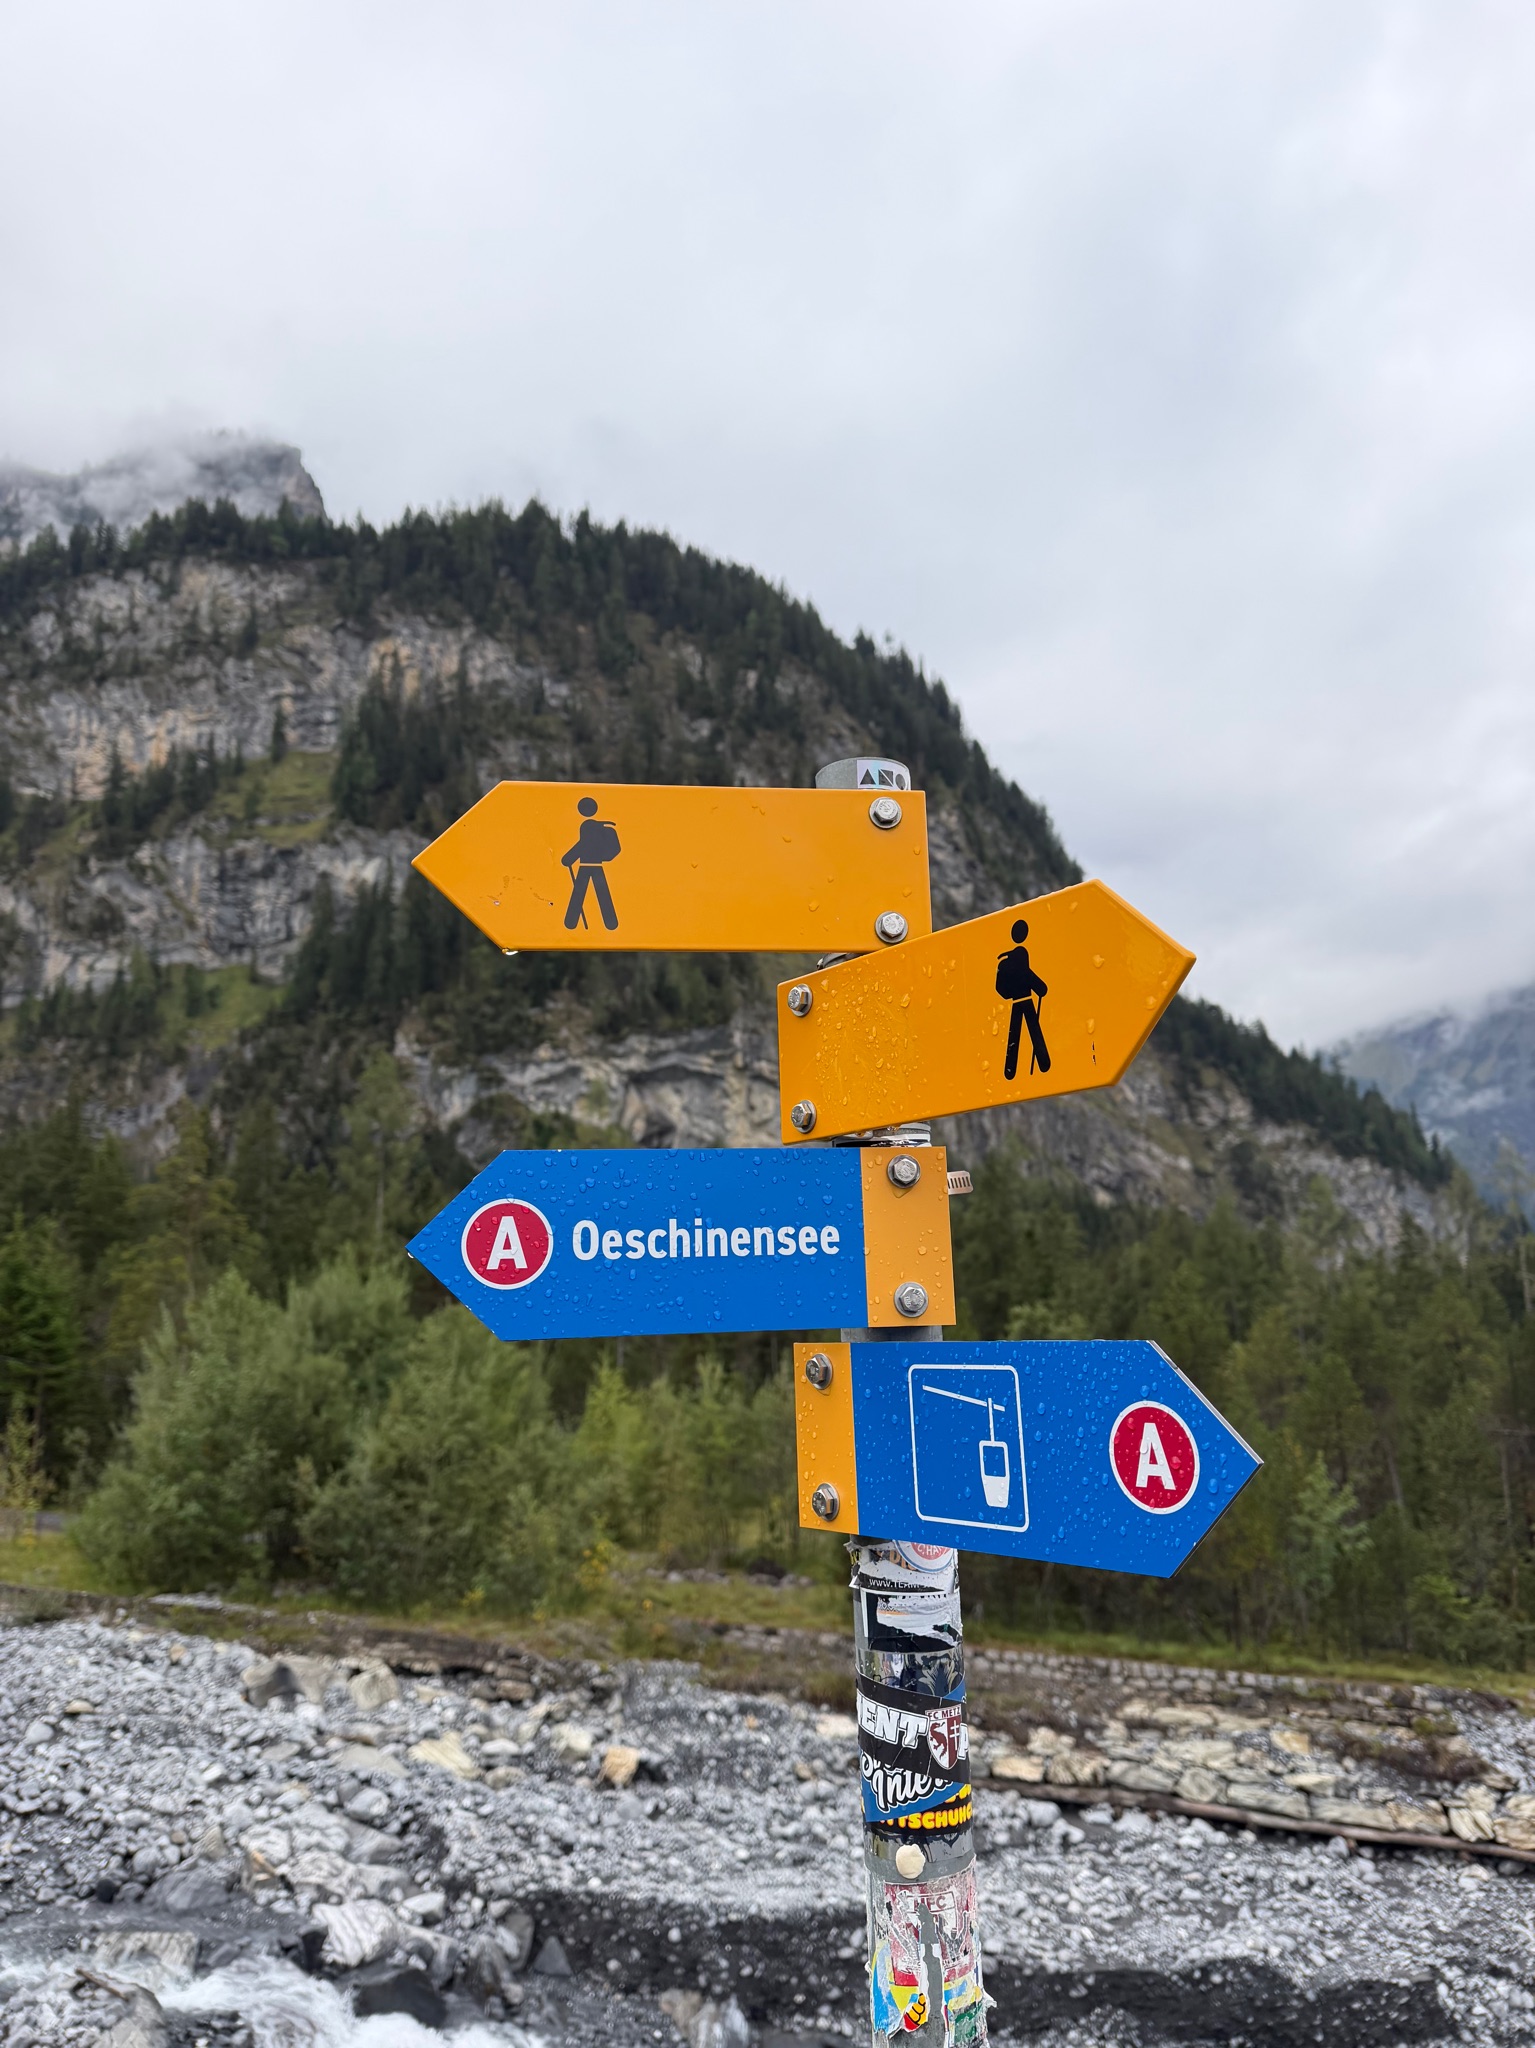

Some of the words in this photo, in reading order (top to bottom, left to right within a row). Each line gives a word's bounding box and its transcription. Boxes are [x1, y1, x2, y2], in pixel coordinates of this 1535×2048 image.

[486, 1215, 528, 1270] A
[571, 1218, 841, 1261] Oeschinensee
[1135, 1422, 1177, 1490] A
[857, 1691, 929, 1749] ENT
[941, 1706, 961, 1718] METZ
